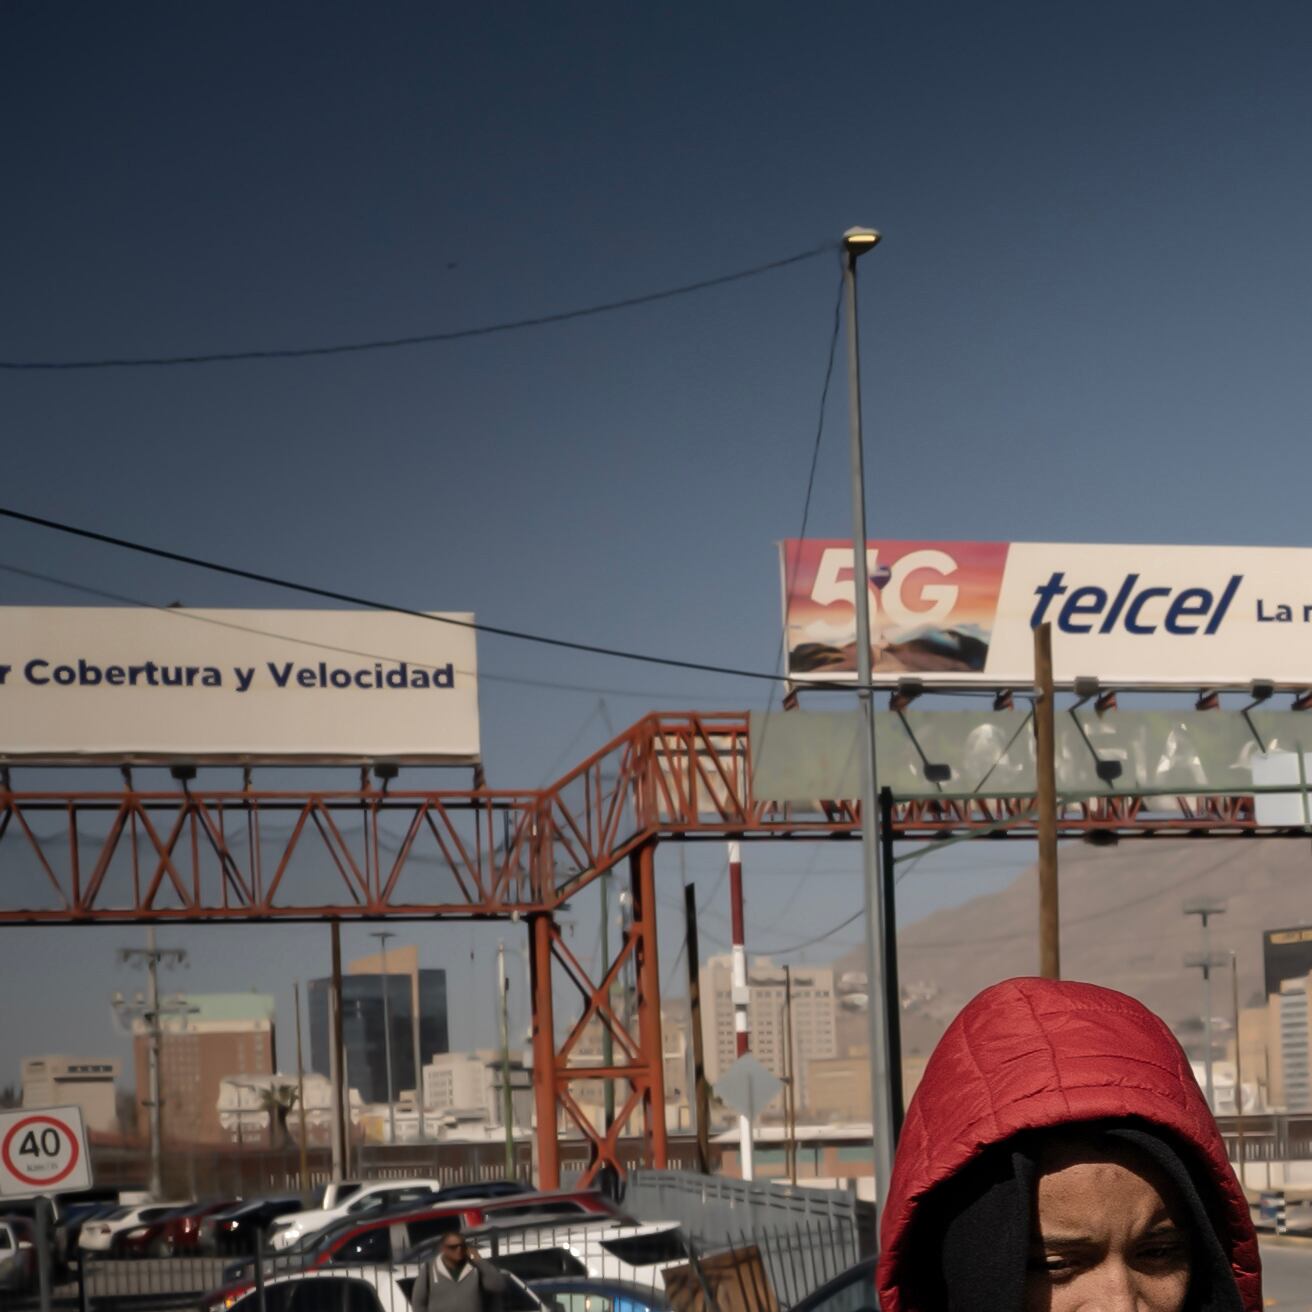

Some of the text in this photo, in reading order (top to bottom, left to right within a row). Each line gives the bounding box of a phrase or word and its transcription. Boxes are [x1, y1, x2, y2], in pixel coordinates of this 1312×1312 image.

[810, 547, 959, 628] 5G
[1030, 572, 1243, 636] telcel
[1256, 598, 1293, 623] La
[23, 658, 223, 688] Cobertura
[234, 667, 256, 693] y
[267, 661, 455, 690] Velocidad
[19, 1128, 61, 1157] 40
